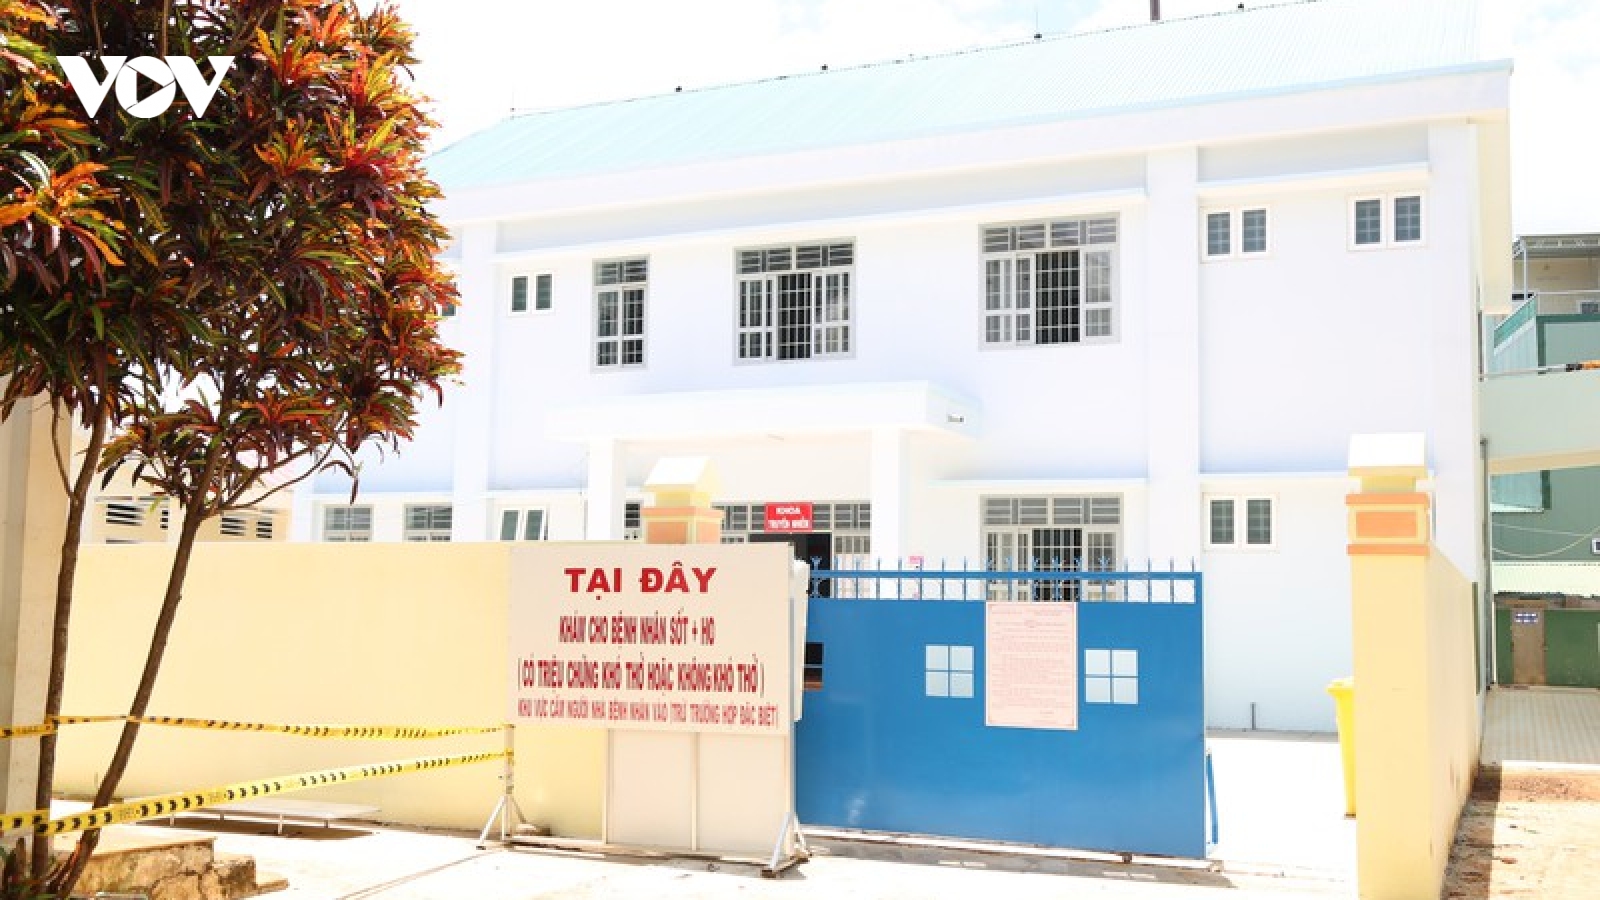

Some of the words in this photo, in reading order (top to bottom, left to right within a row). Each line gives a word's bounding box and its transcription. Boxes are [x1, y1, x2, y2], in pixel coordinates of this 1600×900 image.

[564, 567, 622, 601] TẠI
[639, 561, 717, 593] ĐÂY
[560, 610, 586, 643] KHÁM
[589, 616, 608, 643] CHO
[612, 610, 637, 649] BỆNH
[640, 610, 667, 644] NHÂN
[670, 607, 688, 645] SỐT
[701, 617, 715, 645] HO
[537, 653, 564, 693] TRIỆU
[567, 653, 599, 689] CHỨNG
[602, 654, 621, 690] KHÓ
[626, 652, 644, 690] THỞ
[647, 657, 674, 696] HOẶC
[677, 656, 711, 692] KHÔNG
[713, 656, 734, 692] KHÓ
[517, 698, 532, 717] KHU
[567, 695, 589, 718] NGƯỜI
[608, 697, 627, 721] BỆNH
[630, 697, 649, 721] NHÂN
[690, 699, 720, 725] TRƯỜNG
